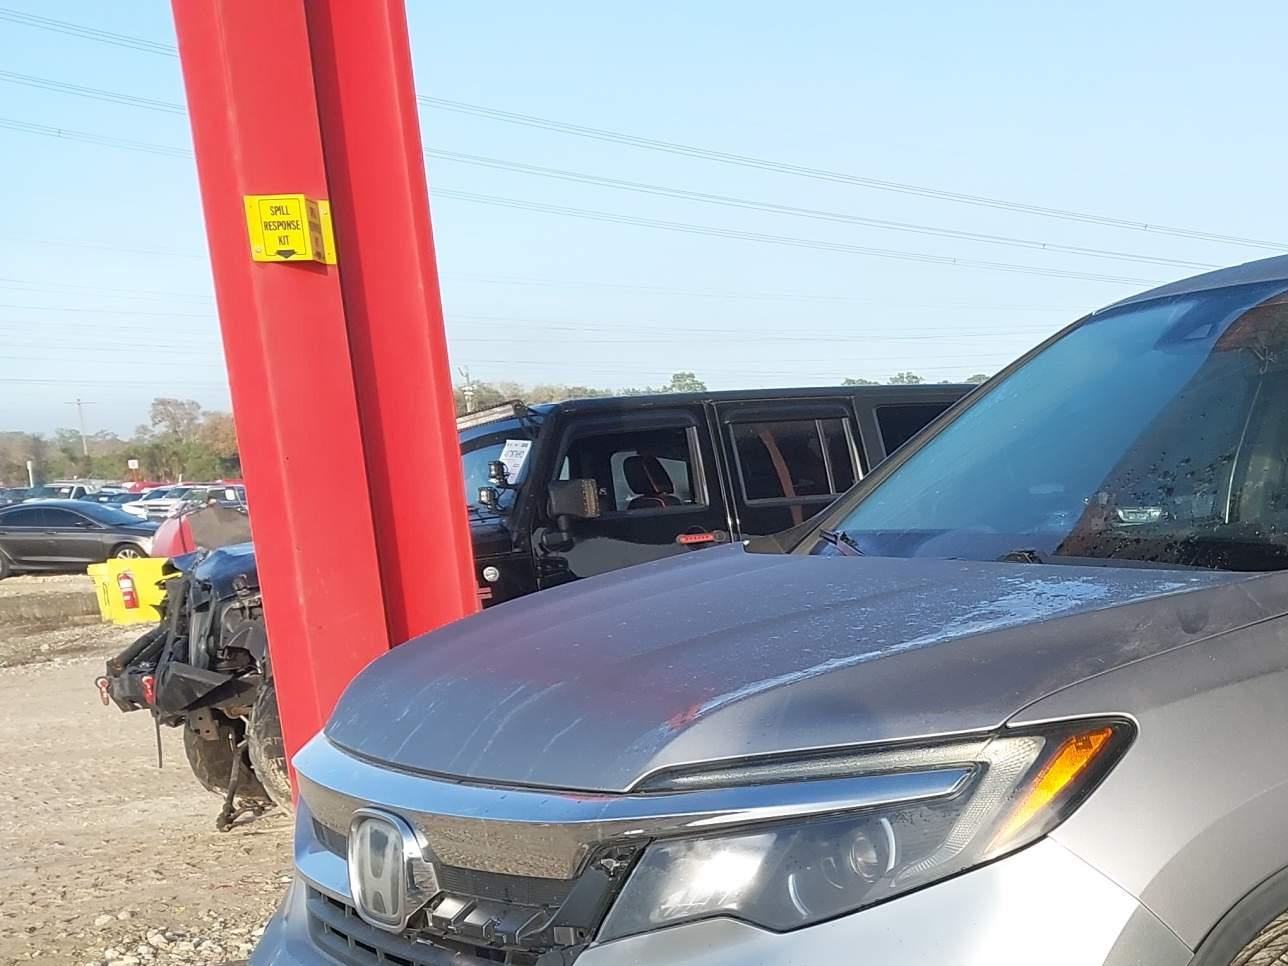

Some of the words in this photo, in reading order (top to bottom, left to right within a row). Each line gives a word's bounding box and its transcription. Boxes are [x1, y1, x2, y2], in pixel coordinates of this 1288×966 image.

[269, 205, 290, 216] SPILL
[263, 220, 301, 231] RESPONSE
[278, 235, 290, 246] KIT
